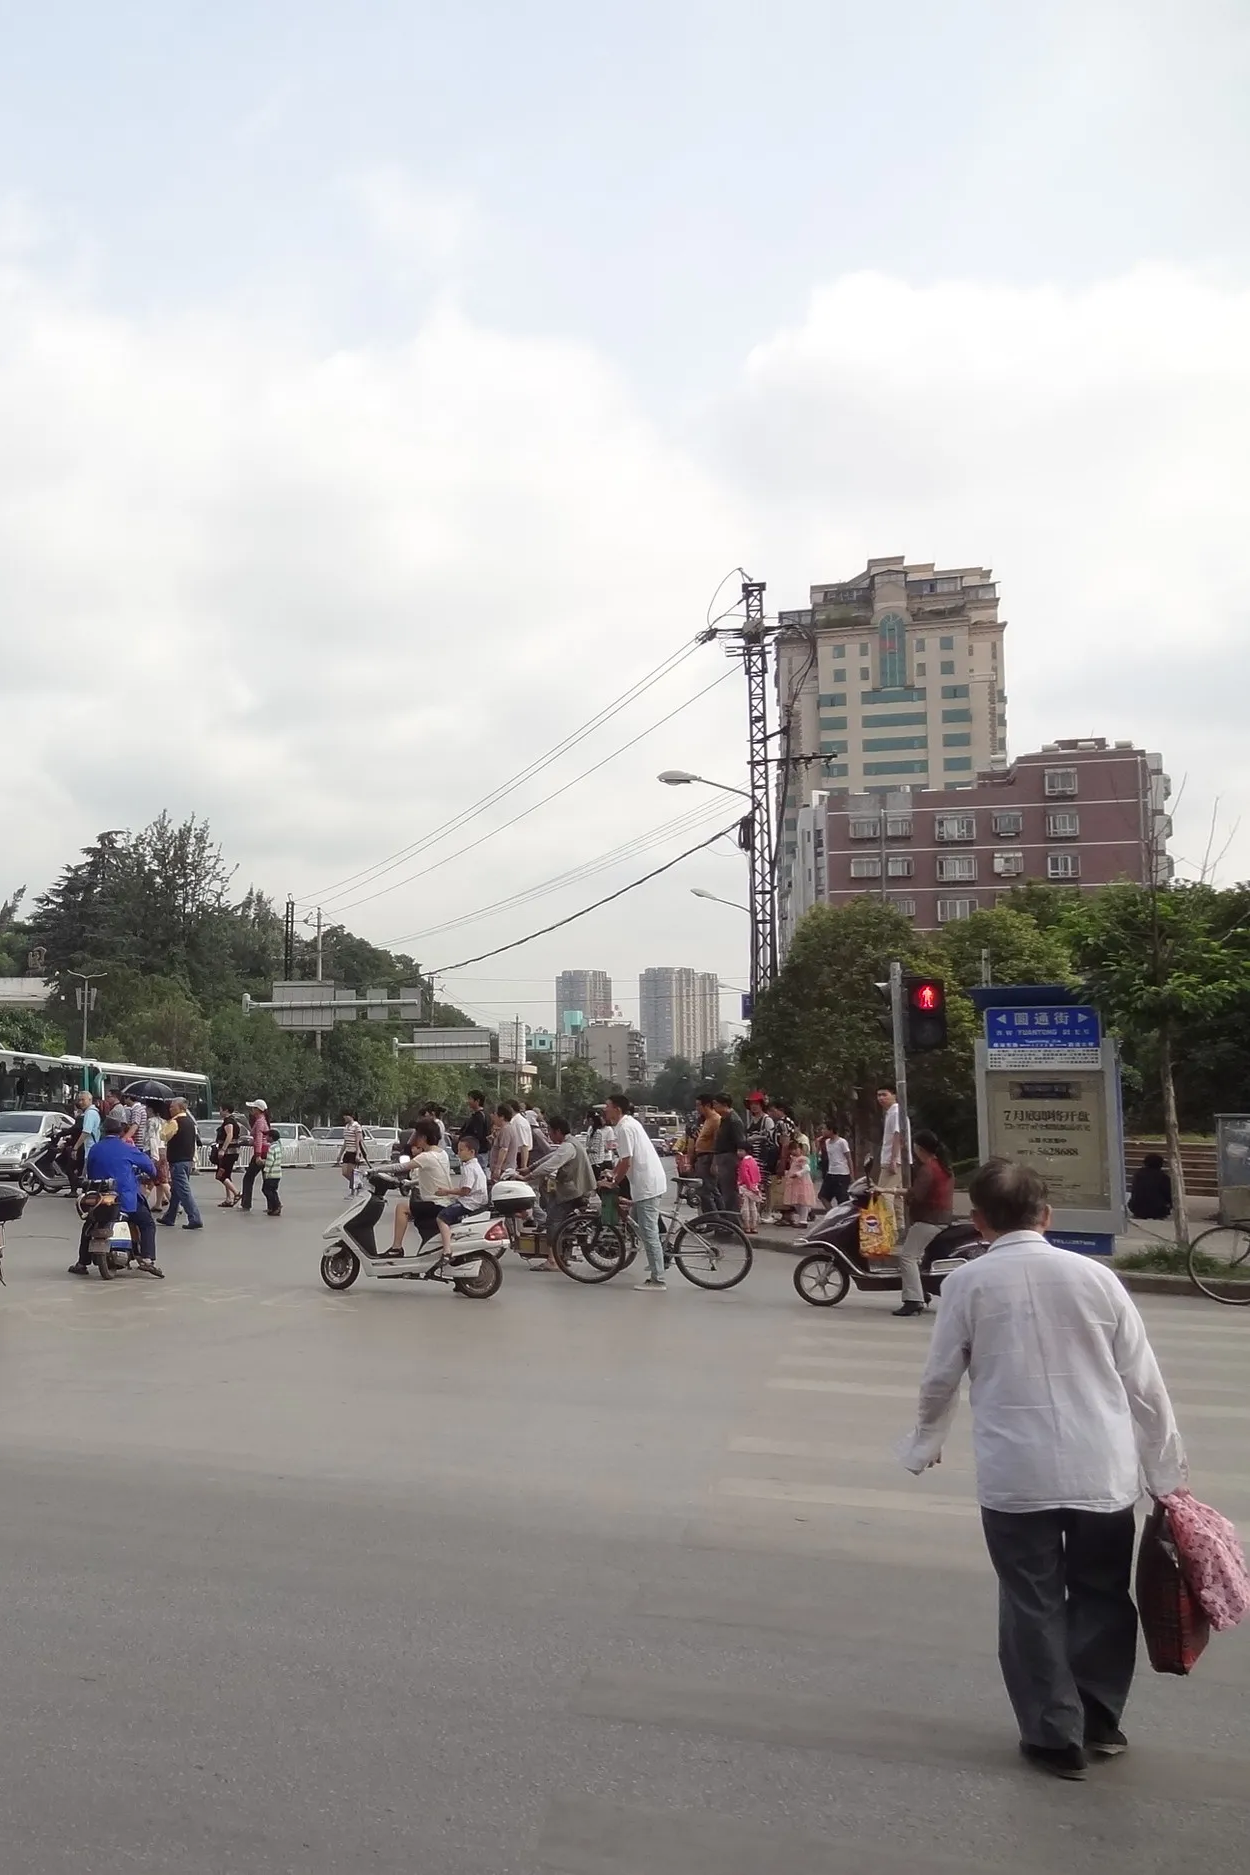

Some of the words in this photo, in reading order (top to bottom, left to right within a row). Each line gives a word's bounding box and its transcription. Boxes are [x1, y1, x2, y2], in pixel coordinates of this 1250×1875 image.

[1003, 1110, 1091, 1122] 7月底即将开盘
